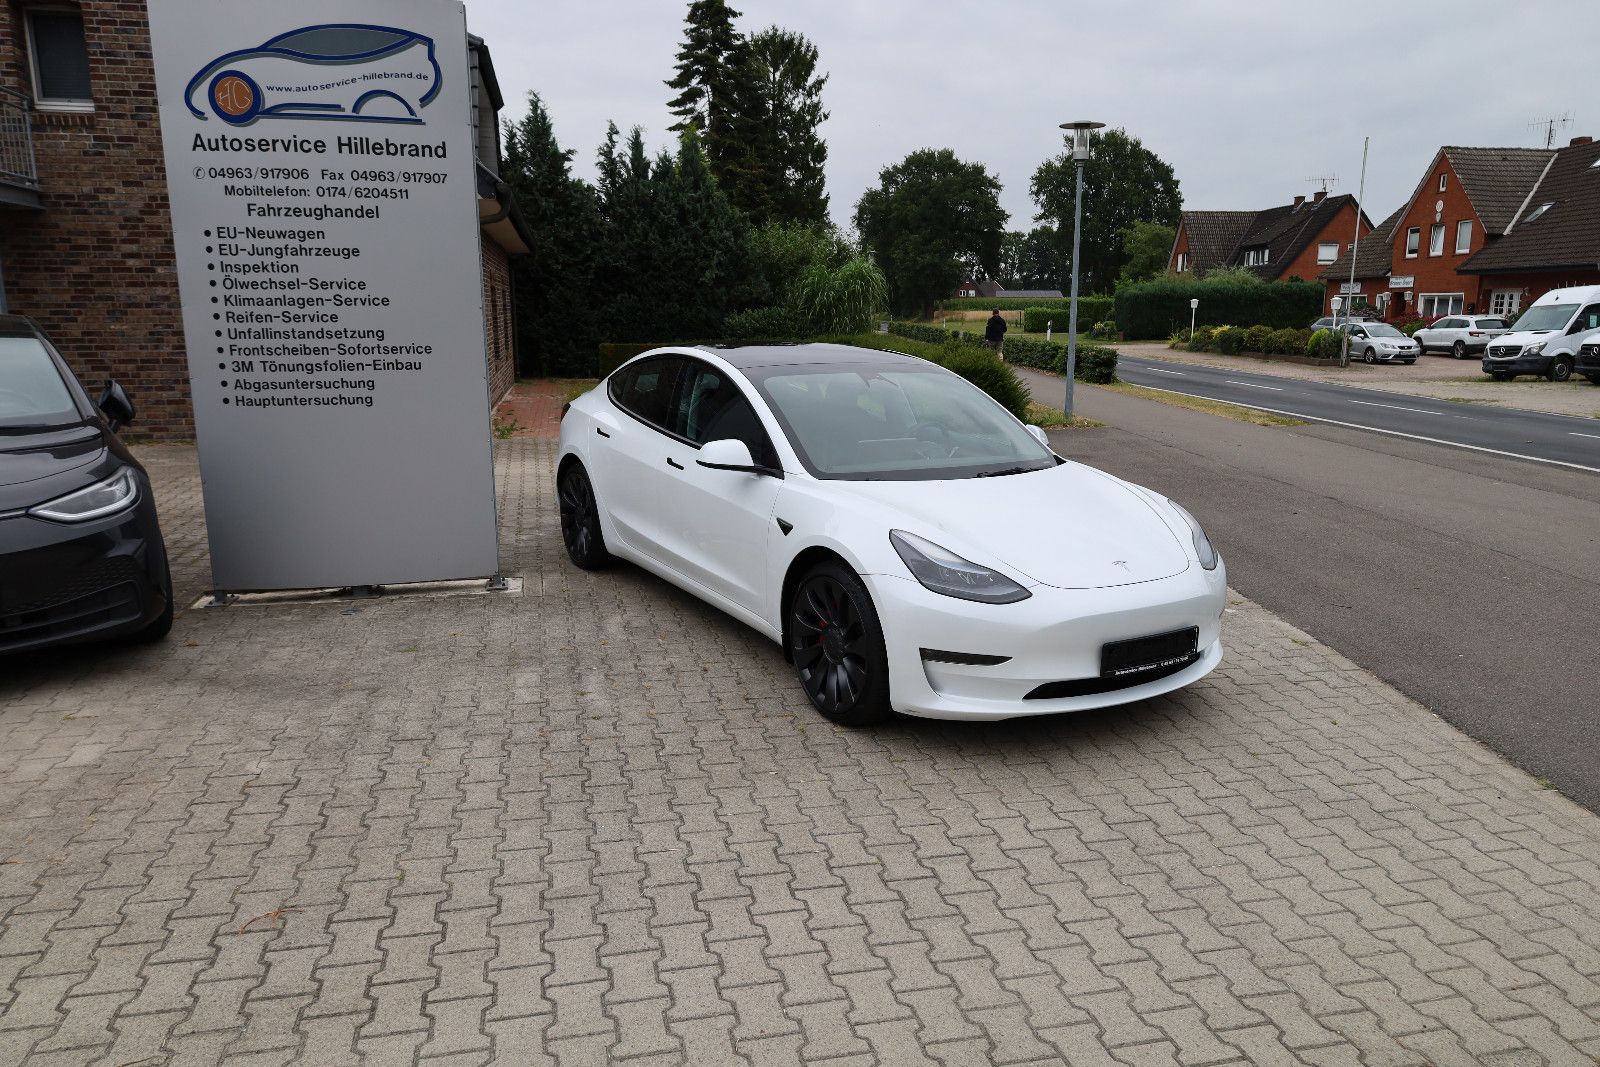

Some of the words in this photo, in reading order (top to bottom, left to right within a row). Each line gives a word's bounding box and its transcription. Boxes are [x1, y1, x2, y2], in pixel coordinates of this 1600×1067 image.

[266, 71, 428, 92] www.autoservice-hillebrand.de
[192, 134, 326, 153] Autoservice
[337, 136, 447, 158] Hillebrand
[208, 167, 310, 180] 04963/917906
[321, 169, 344, 181] Fax
[351, 169, 447, 183] 04963/917907
[224, 185, 311, 197] Mobiltelefon:
[316, 186, 409, 199] 0174/6204511
[247, 203, 380, 220] Fahrzeughandel
[217, 227, 325, 241] EU-Neuwagen
[218, 244, 360, 259] EU-Jungfahrzeuge
[220, 261, 299, 274] Inspektion
[222, 275, 366, 290] Ölwechsel-Service
[224, 294, 390, 308] Klimaanlagen-Service
[226, 311, 339, 323] Reifen-Service
[228, 327, 385, 341] Unfallinstandsetzung
[229, 343, 432, 357] Frontscheiben-Sofortservice
[232, 361, 254, 372] 3M
[260, 359, 422, 374] Tönungsfolien-Einbau
[234, 378, 375, 392] Abgasuntersuchung
[235, 395, 373, 408] Hauptuntersuchung
